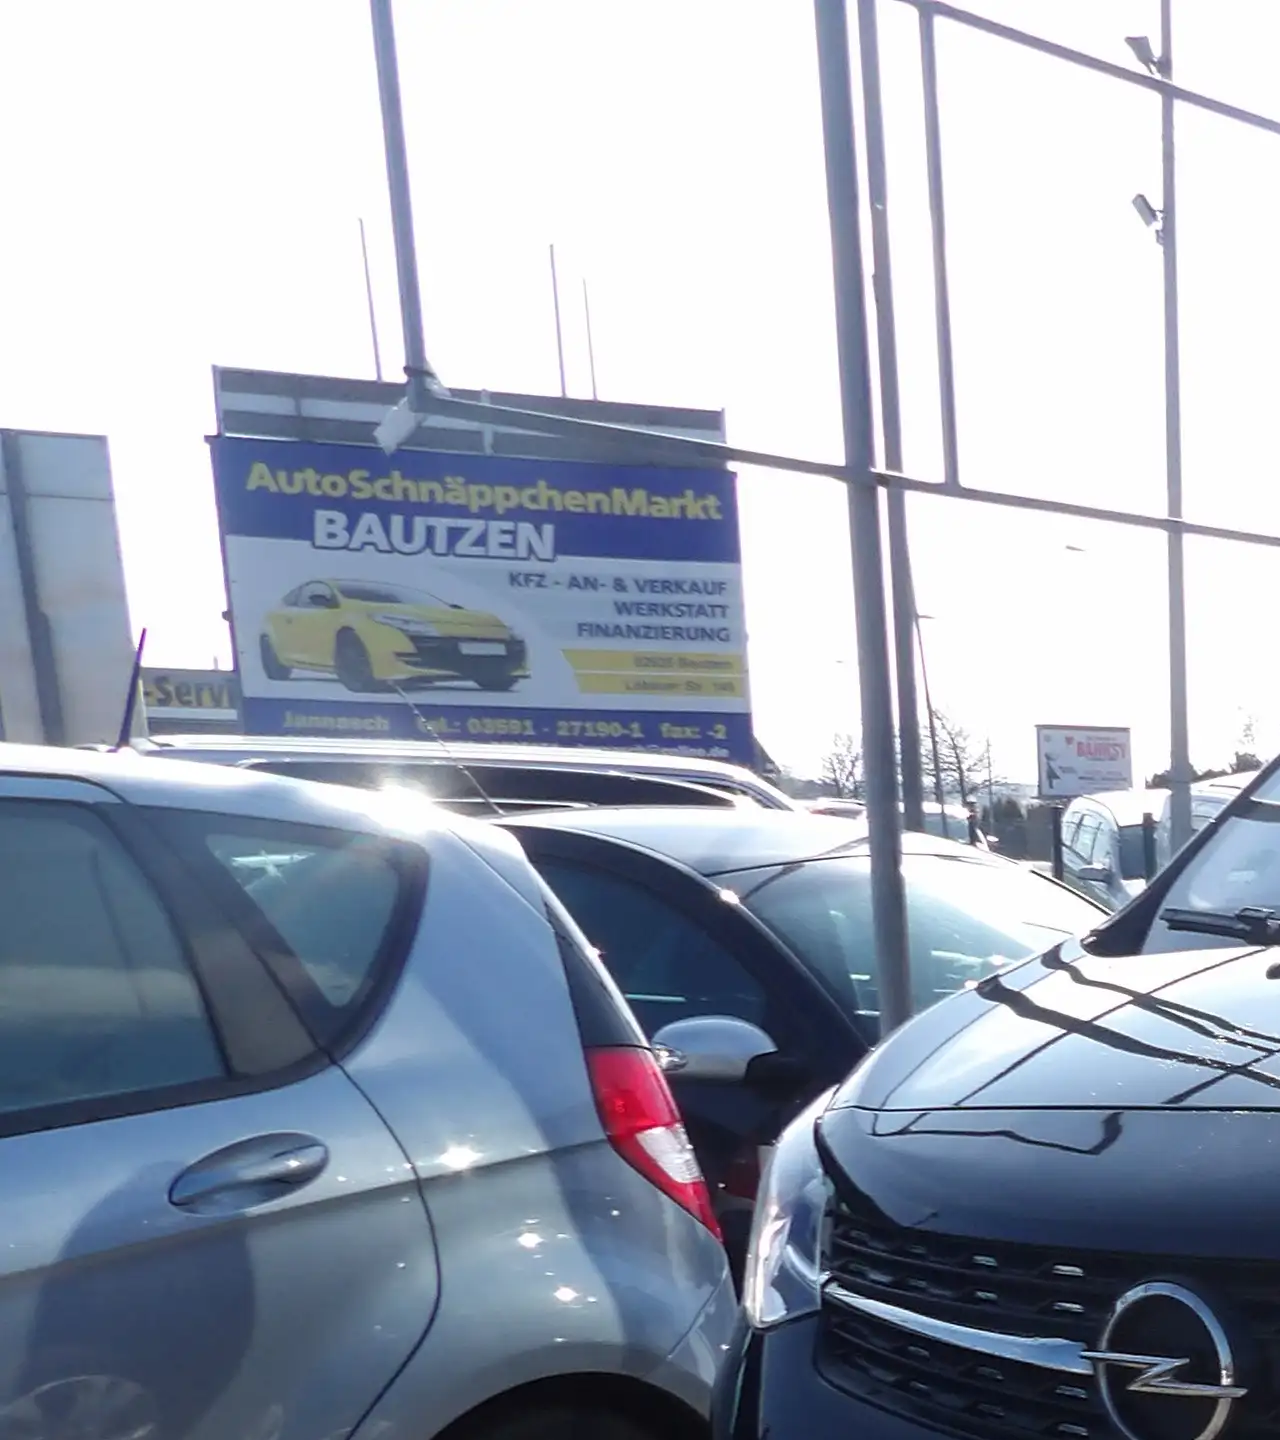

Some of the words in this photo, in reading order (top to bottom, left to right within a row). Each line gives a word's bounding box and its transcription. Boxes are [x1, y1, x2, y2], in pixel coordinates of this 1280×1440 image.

[246, 462, 723, 520] AutoSchnäppchenMarkt
[313, 509, 557, 562] BAUTZEN
[508, 572, 548, 589] KFZ
[612, 577, 629, 593] &
[634, 578, 728, 596] VERKAUF
[613, 600, 731, 618] WERKSTATT
[576, 622, 732, 642] FINANZIERUNG
[467, 716, 535, 736] 03591
